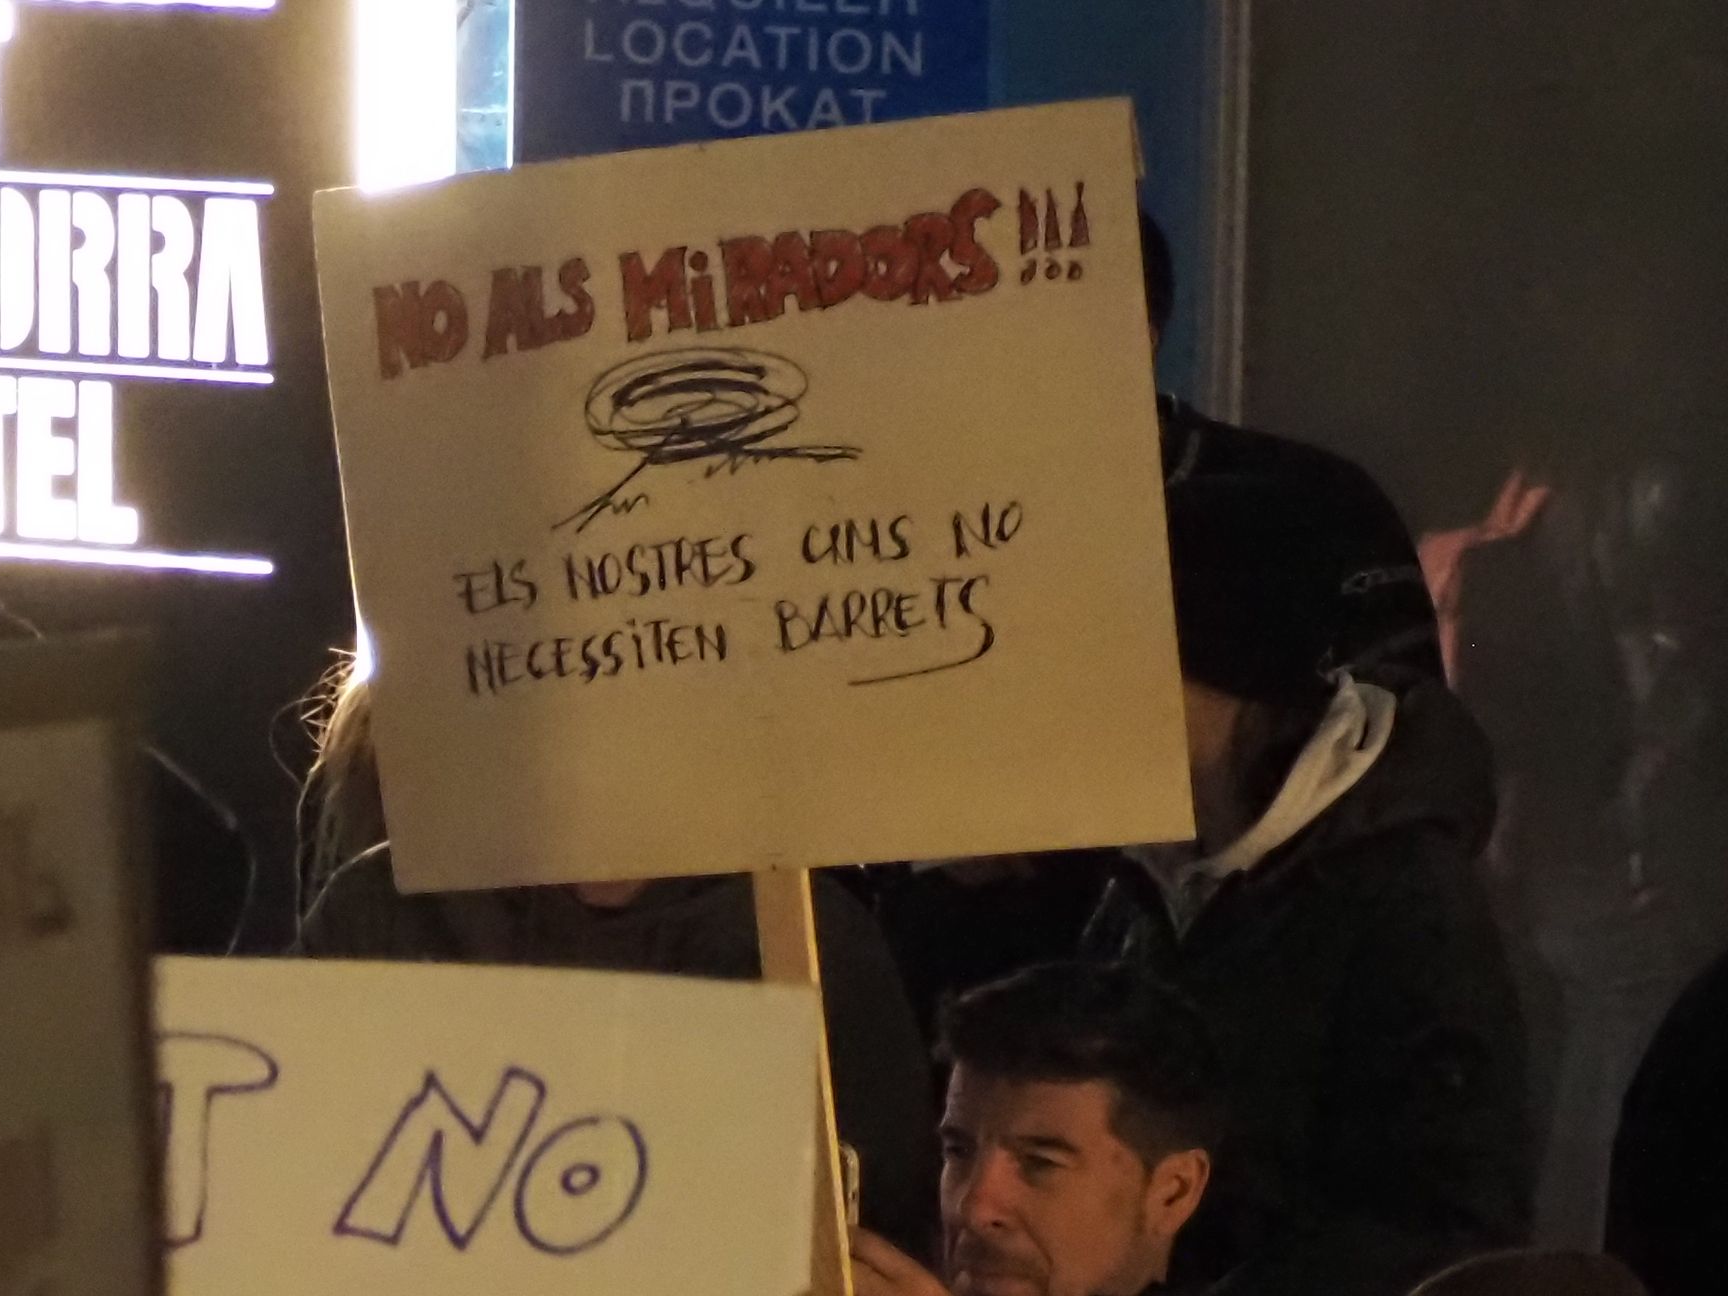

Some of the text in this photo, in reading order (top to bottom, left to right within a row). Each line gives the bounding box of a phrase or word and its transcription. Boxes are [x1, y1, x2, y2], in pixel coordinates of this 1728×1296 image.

[584, 18, 924, 76] LOCATION
[620, 78, 887, 130] ПРОКАТ
[372, 278, 470, 380] NO
[481, 256, 596, 360] ALS
[563, 532, 757, 600] NOSTRES
[951, 499, 1024, 558] NO
[774, 572, 996, 688] BARRETS
[332, 1063, 648, 1257] NO
